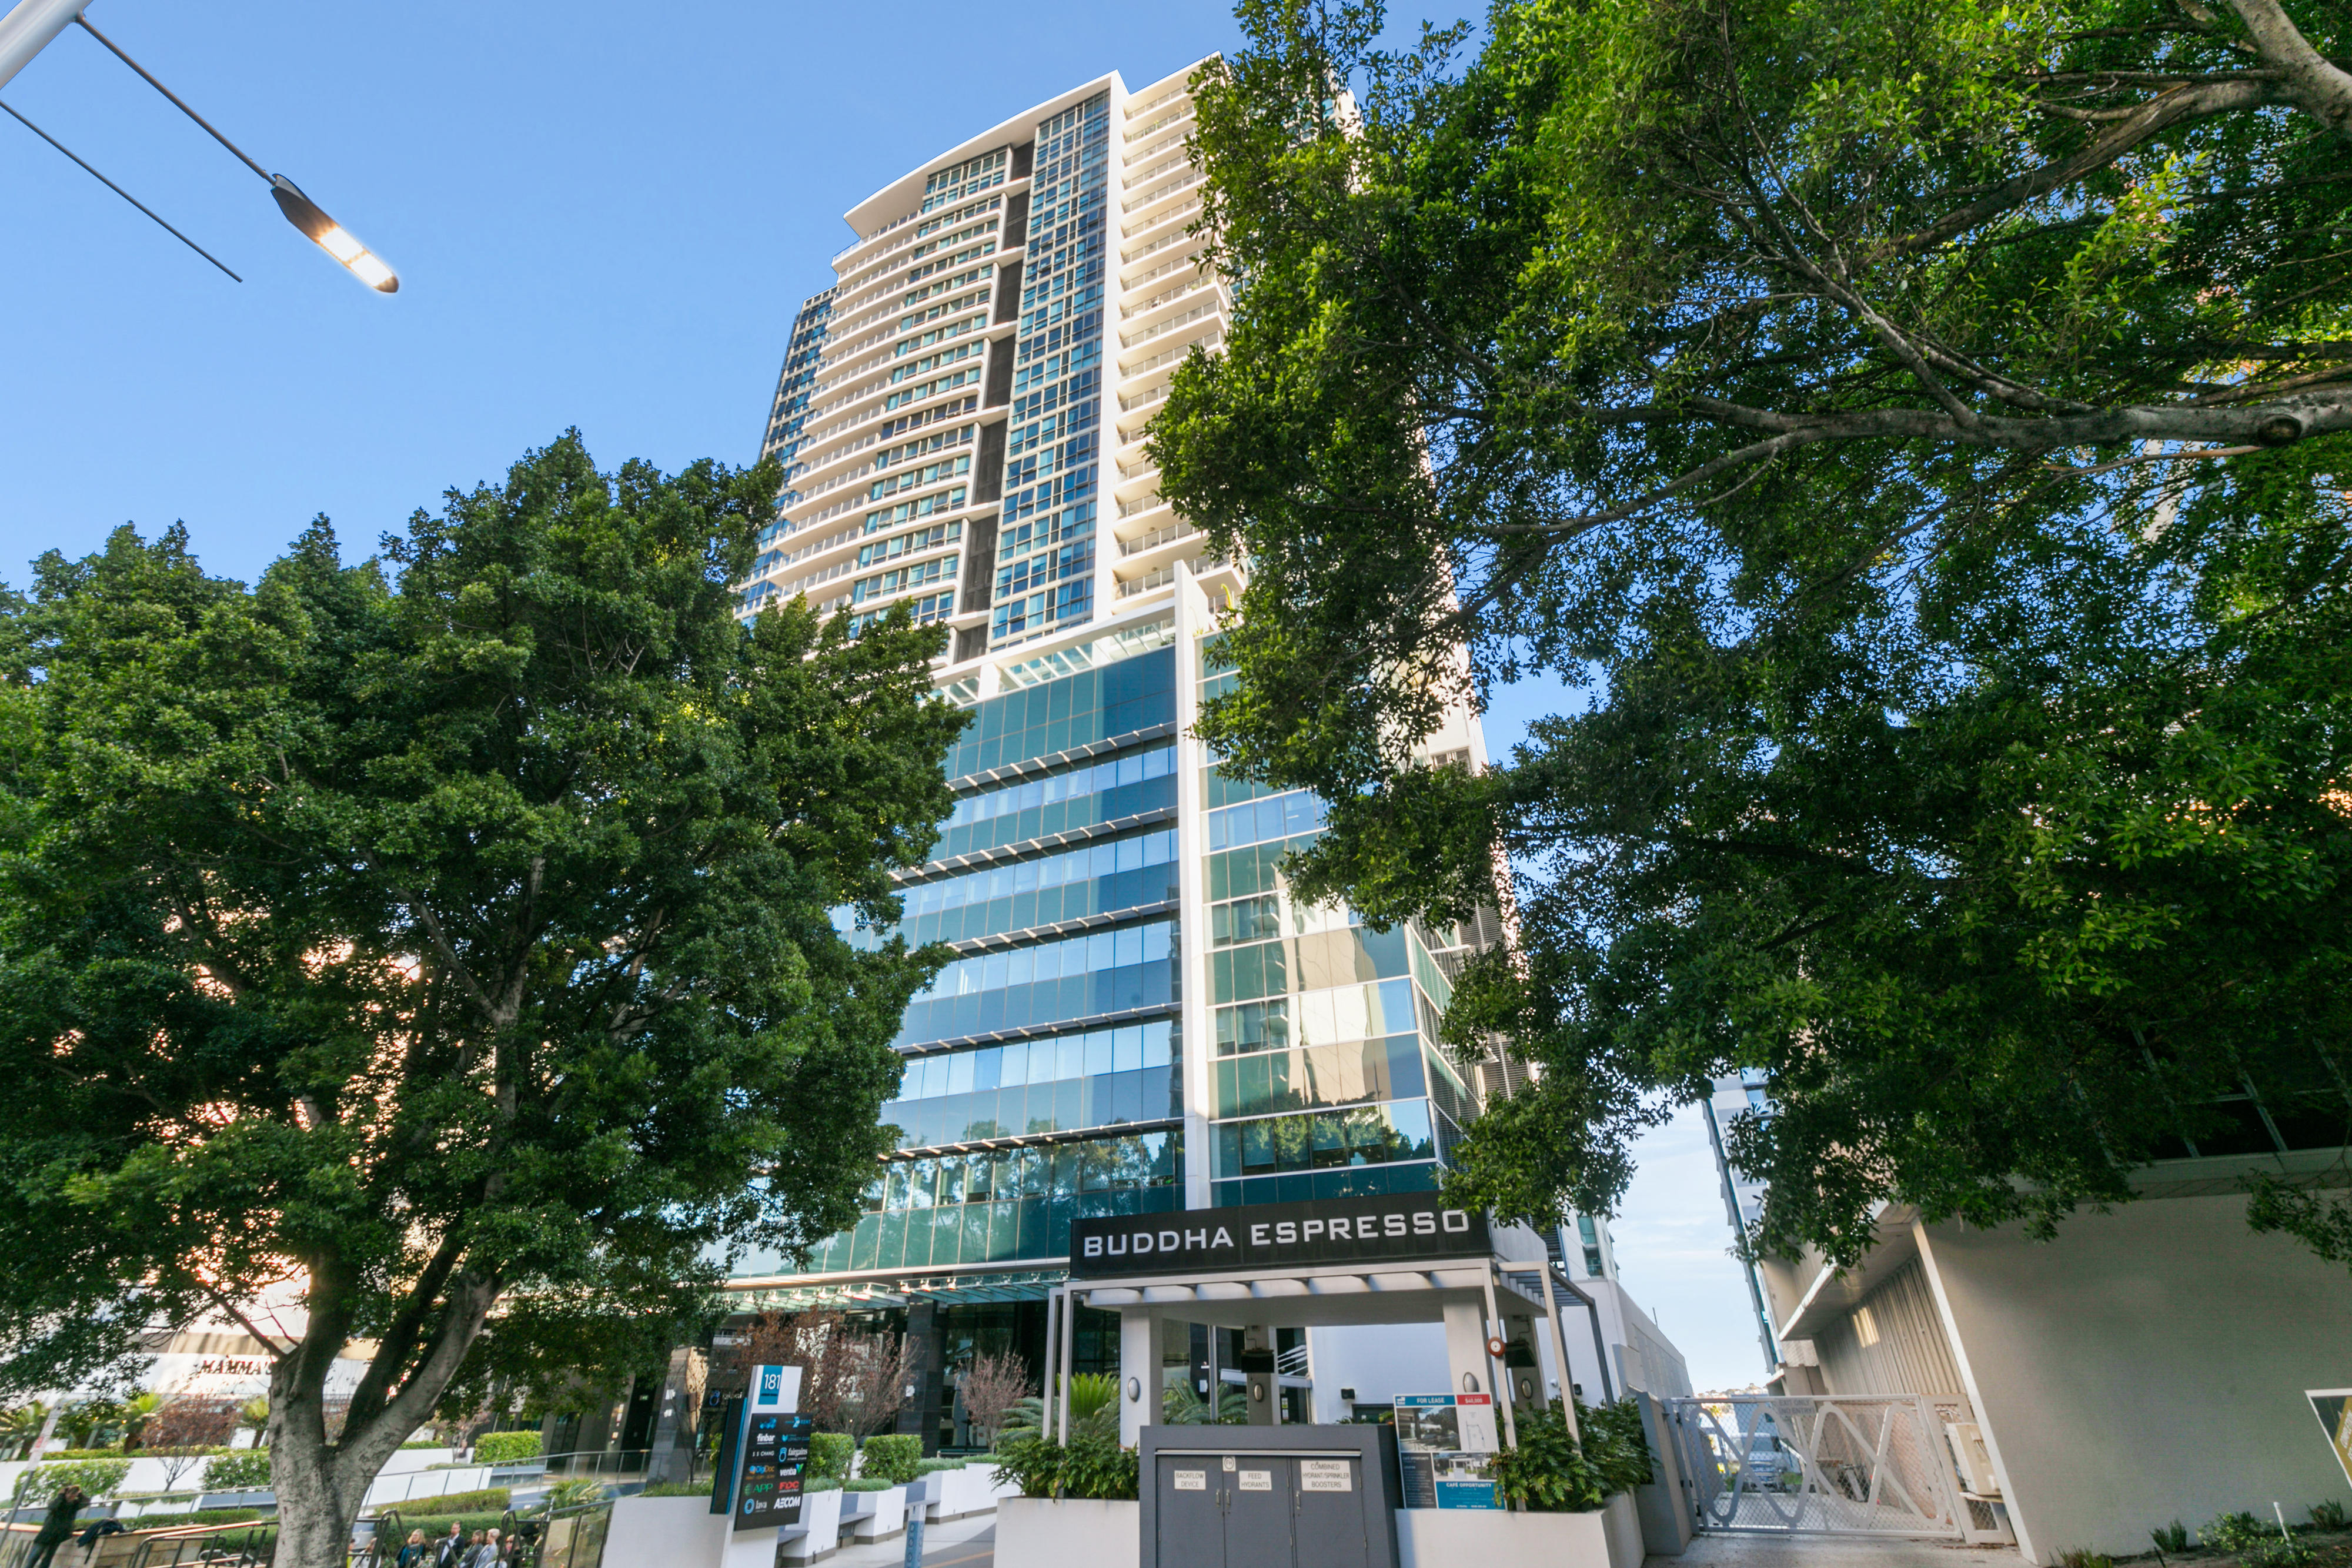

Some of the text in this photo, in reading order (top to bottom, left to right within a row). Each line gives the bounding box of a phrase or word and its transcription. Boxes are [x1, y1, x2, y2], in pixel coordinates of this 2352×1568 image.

[1084, 1209, 1469, 1257] BUDDHA ESPRESSO
[764, 1373, 781, 1390] 181
[757, 1433, 775, 1442] finbar
[753, 1483, 773, 1493] APP
[779, 1481, 799, 1490] FDC
[773, 1496, 801, 1509] AECOM
